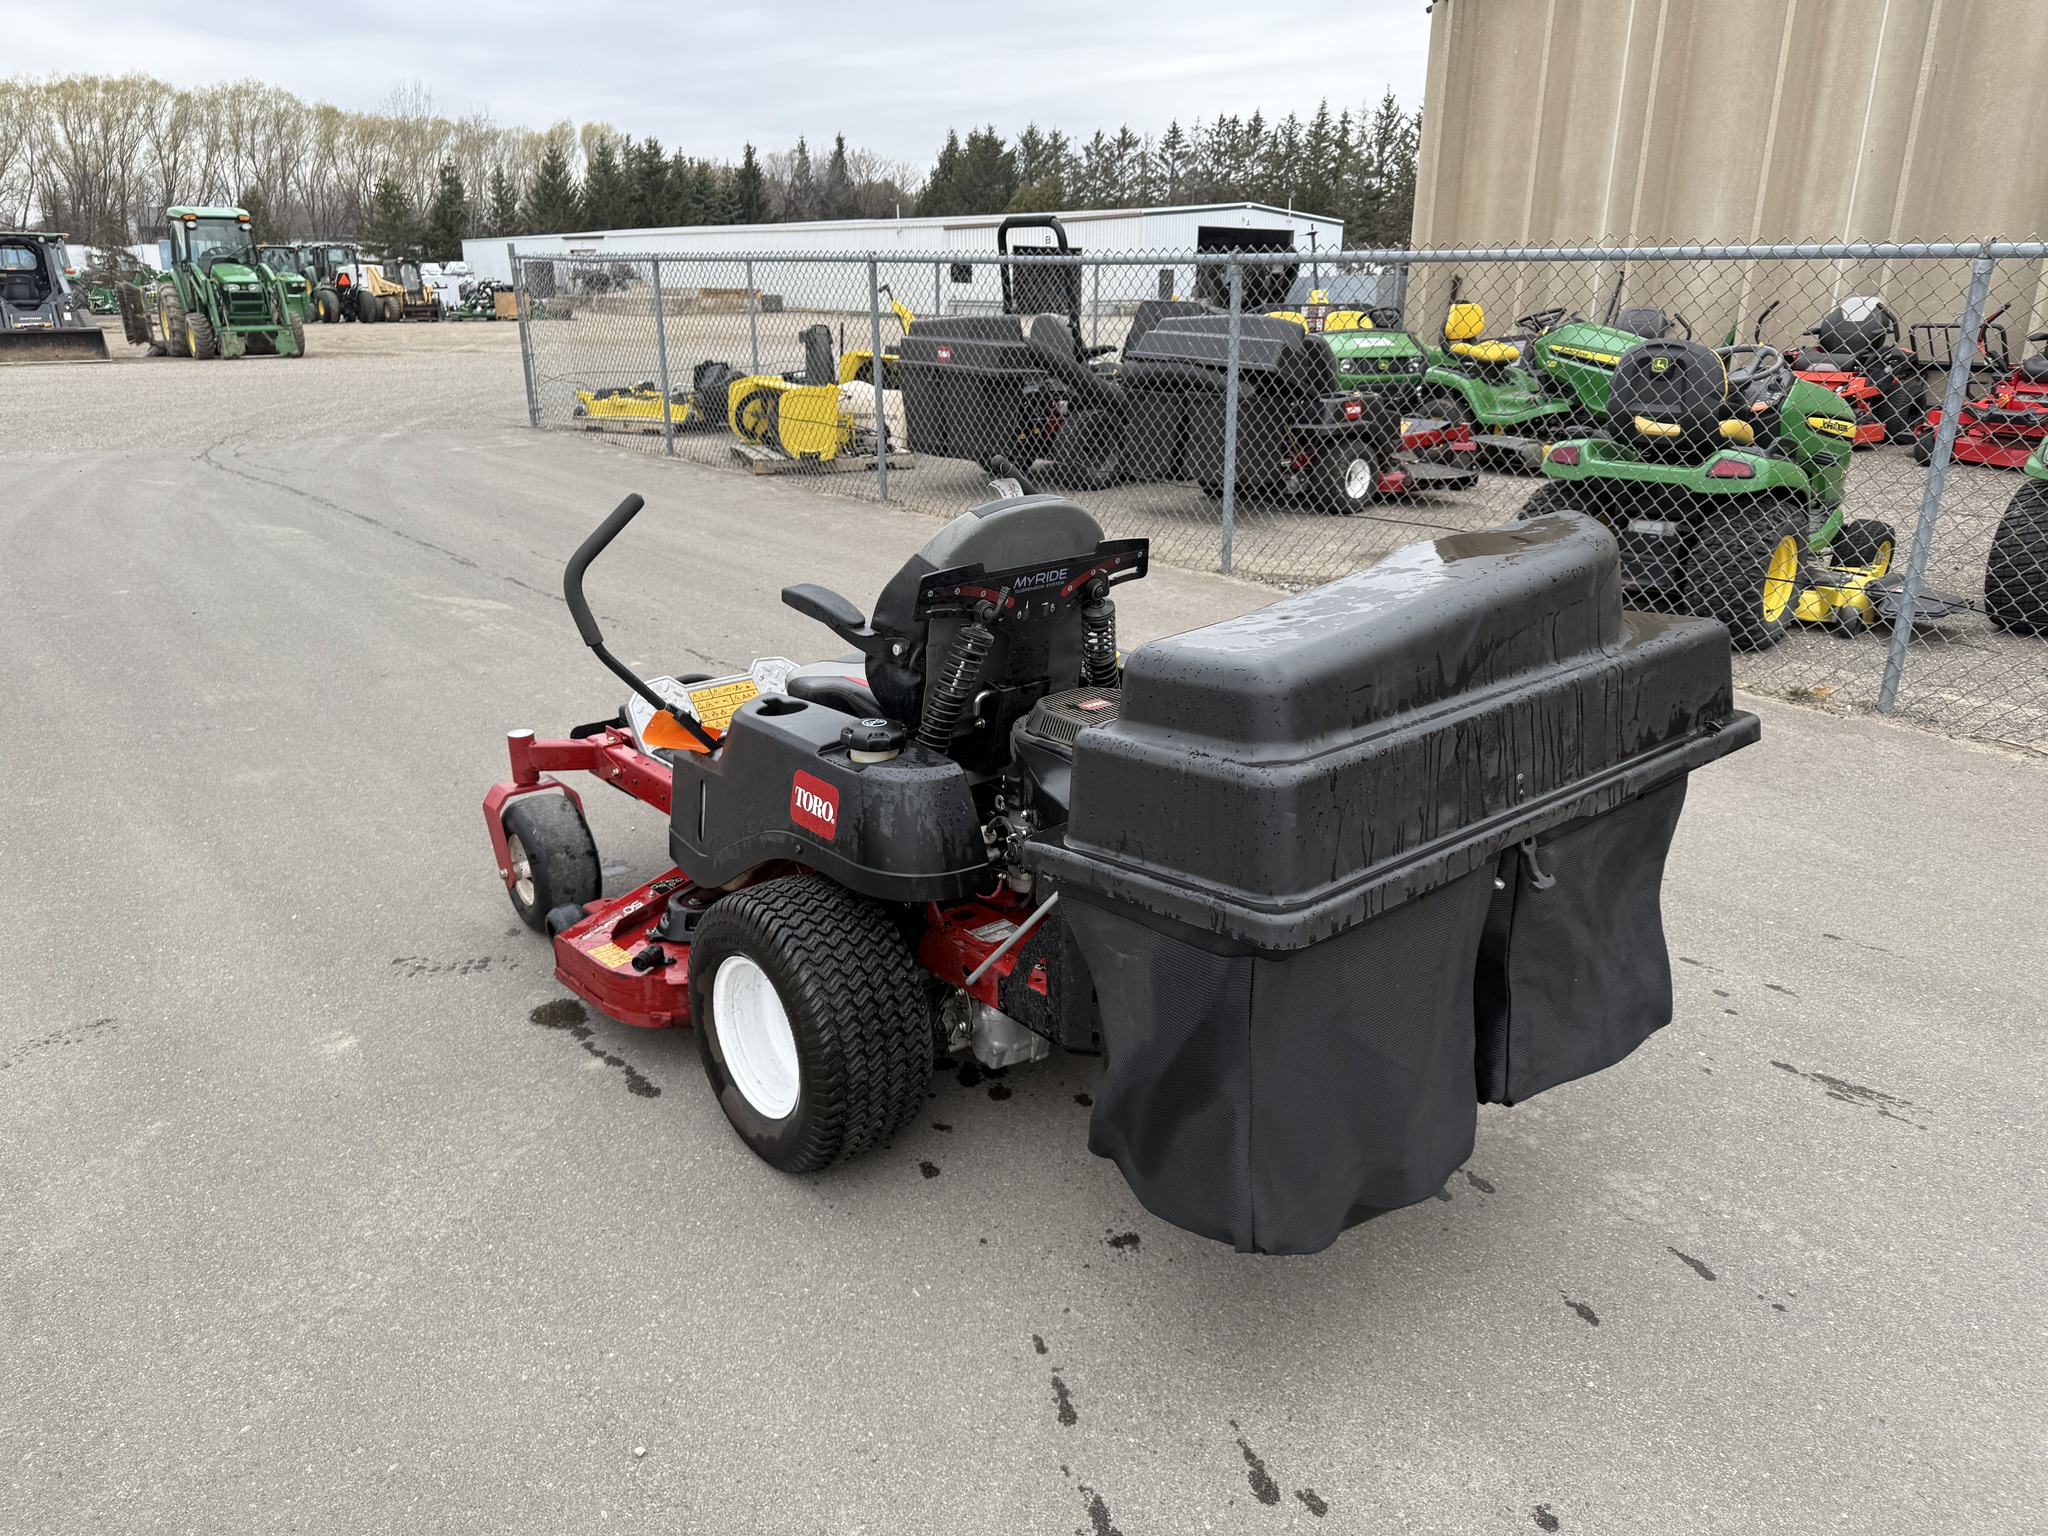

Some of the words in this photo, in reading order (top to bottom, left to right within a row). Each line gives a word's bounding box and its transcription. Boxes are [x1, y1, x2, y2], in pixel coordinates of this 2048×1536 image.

[1045, 235, 1051, 244] B
[1014, 584, 1045, 594] SUSPENSION
[1045, 580, 1065, 588] SYSTEM
[794, 785, 835, 825] TORO
